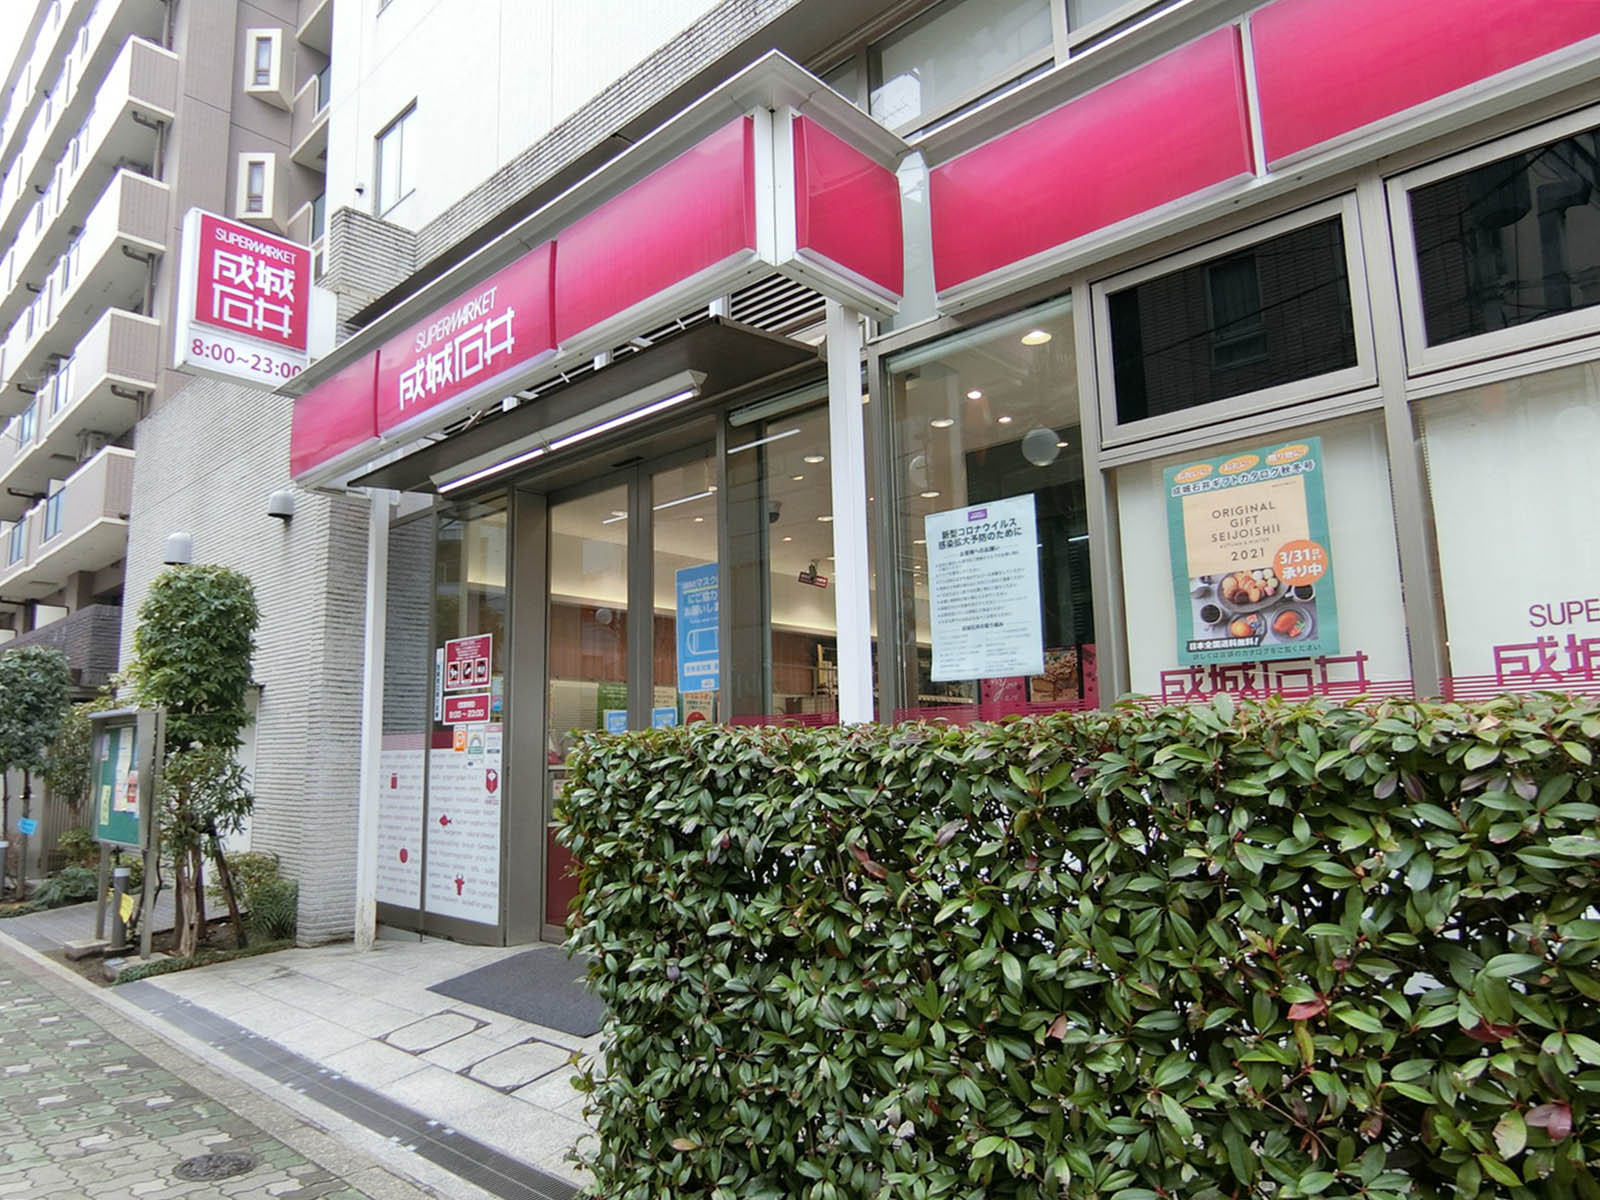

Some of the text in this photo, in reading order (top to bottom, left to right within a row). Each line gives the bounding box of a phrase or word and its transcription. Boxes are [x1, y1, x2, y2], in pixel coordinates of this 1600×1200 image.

[215, 227, 296, 265] SUPERMARKET
[212, 249, 296, 304] 成城
[211, 283, 294, 339] 石井
[415, 286, 498, 353] SUPERMARKET
[399, 306, 515, 411] 成城石井
[1212, 501, 1276, 519] ORIGINAL
[1230, 515, 1259, 528] GIFT
[1211, 524, 1281, 543] SEIJOISHII
[1231, 547, 1265, 562] 2021
[1160, 650, 1369, 704] 成城石井
